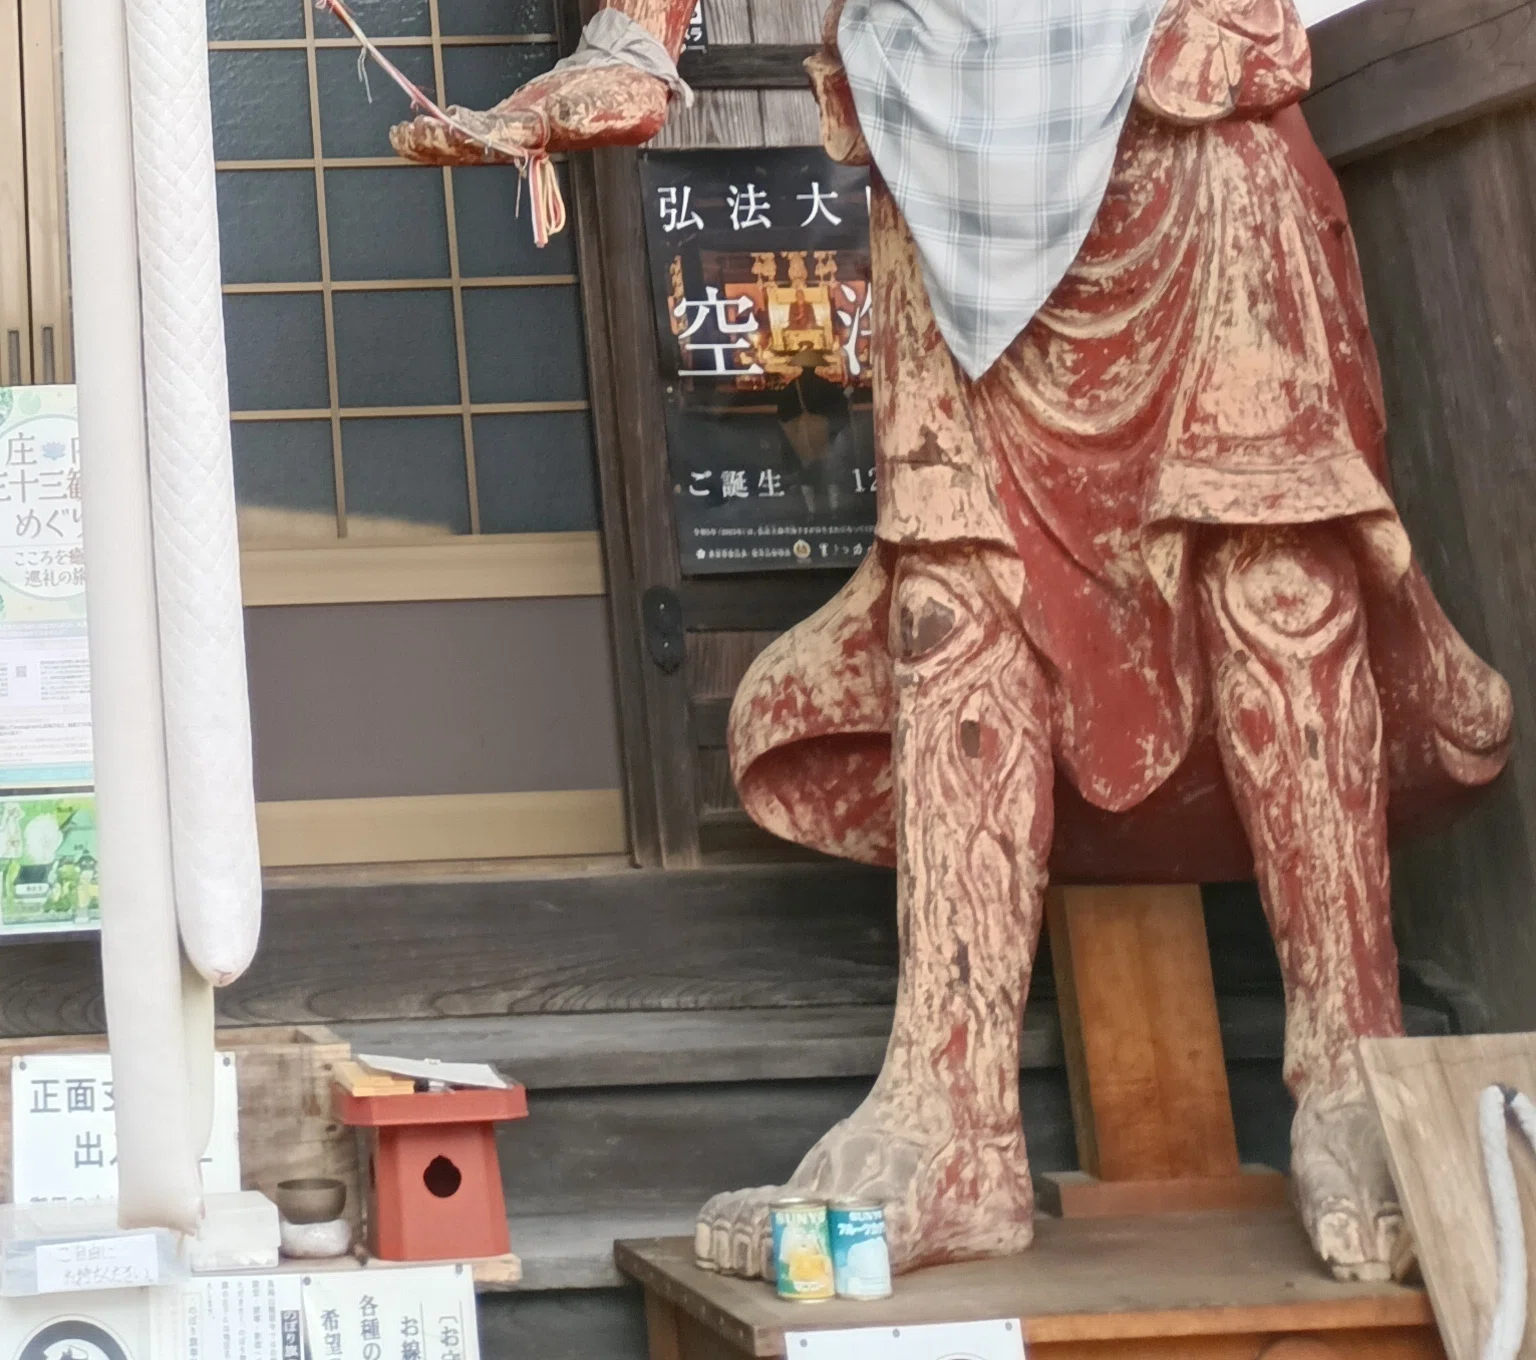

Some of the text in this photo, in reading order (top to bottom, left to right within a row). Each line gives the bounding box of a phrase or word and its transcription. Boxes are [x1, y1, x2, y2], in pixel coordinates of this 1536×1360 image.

[657, 181, 872, 232] 弘法大
[689, 468, 785, 497] ご誕生
[321, 1309, 342, 1360] 希望
